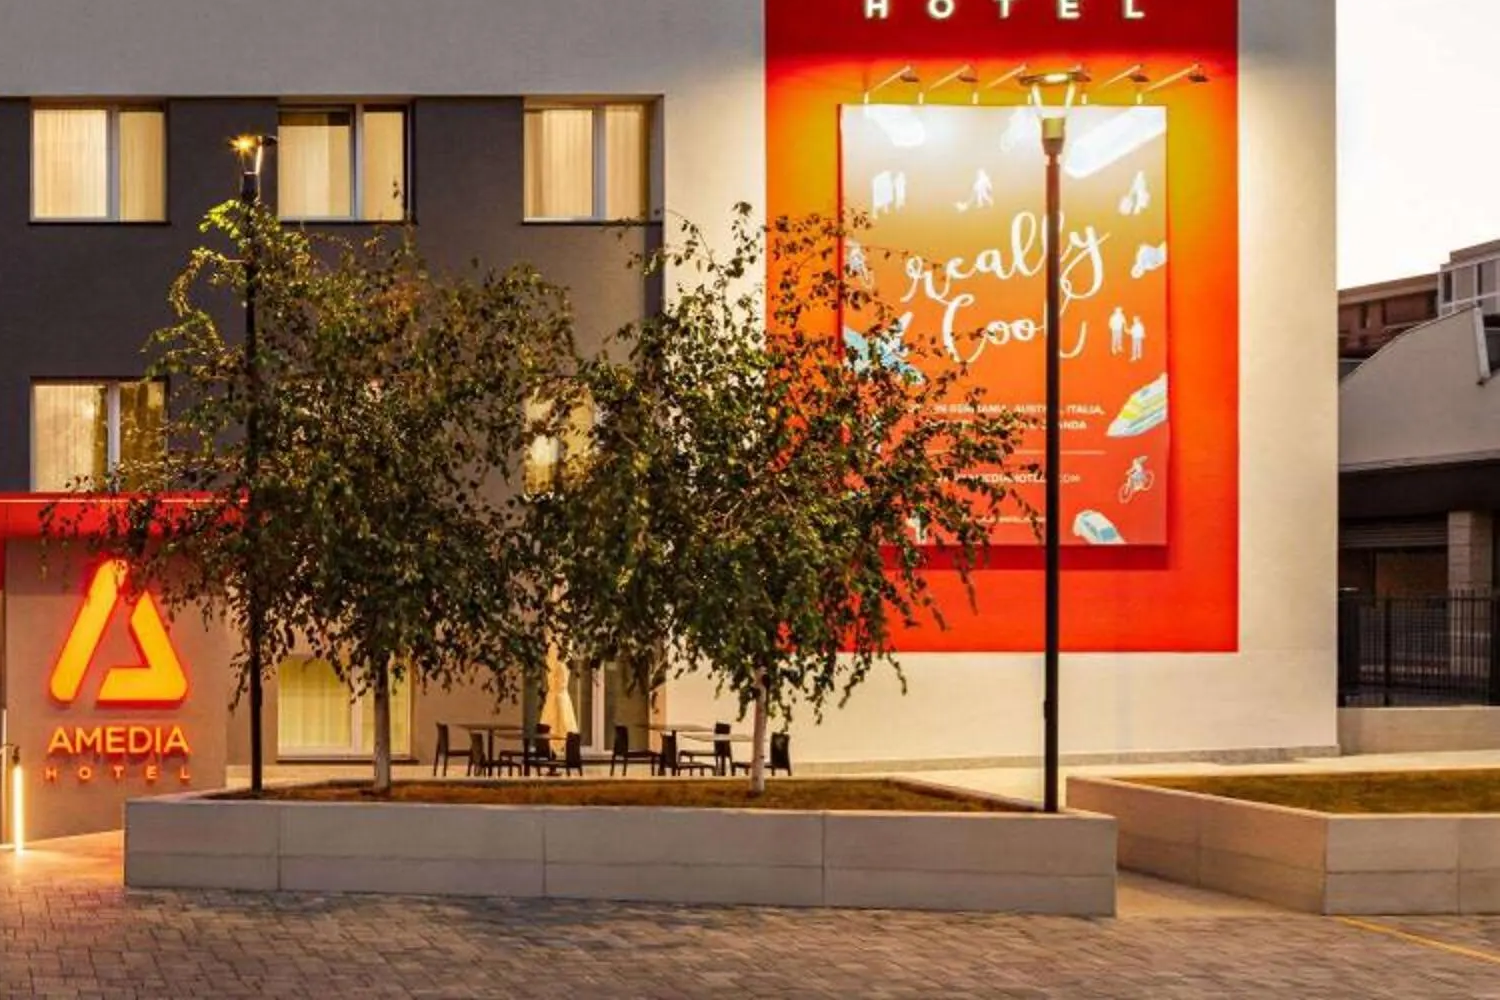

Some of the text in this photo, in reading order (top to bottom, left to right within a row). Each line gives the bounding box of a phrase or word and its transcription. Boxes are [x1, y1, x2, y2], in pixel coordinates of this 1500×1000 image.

[900, 211, 1111, 303] really
[1067, 403, 1107, 416] ITALIA,
[48, 727, 191, 754] AMEDIA
[45, 766, 190, 780] HOTEL
